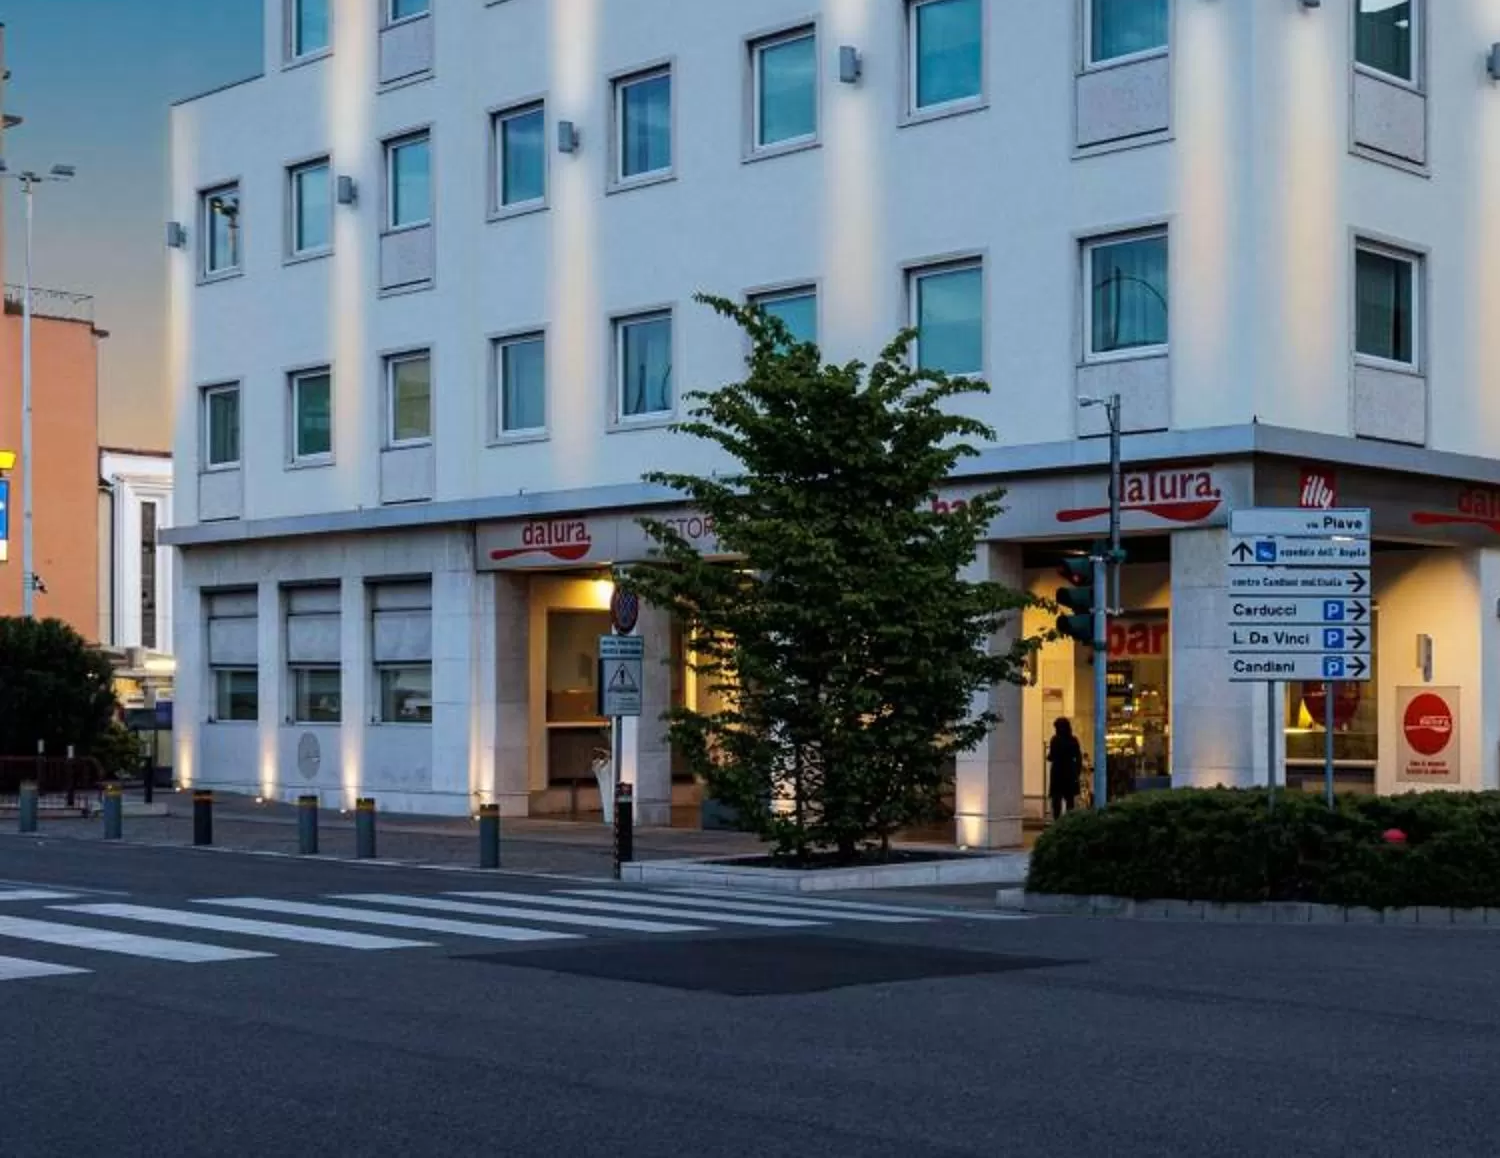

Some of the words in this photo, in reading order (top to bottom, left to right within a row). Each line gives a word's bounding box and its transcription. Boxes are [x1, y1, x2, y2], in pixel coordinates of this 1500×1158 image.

[1302, 475, 1334, 510] illy
[1323, 516, 1363, 530] Piave
[1233, 603, 1296, 617] Carducci
[1327, 603, 1339, 617] P
[1250, 631, 1270, 645] Da
[1275, 631, 1310, 645] Vinci
[1327, 632, 1339, 645] P
[1233, 659, 1295, 673] Candiani
